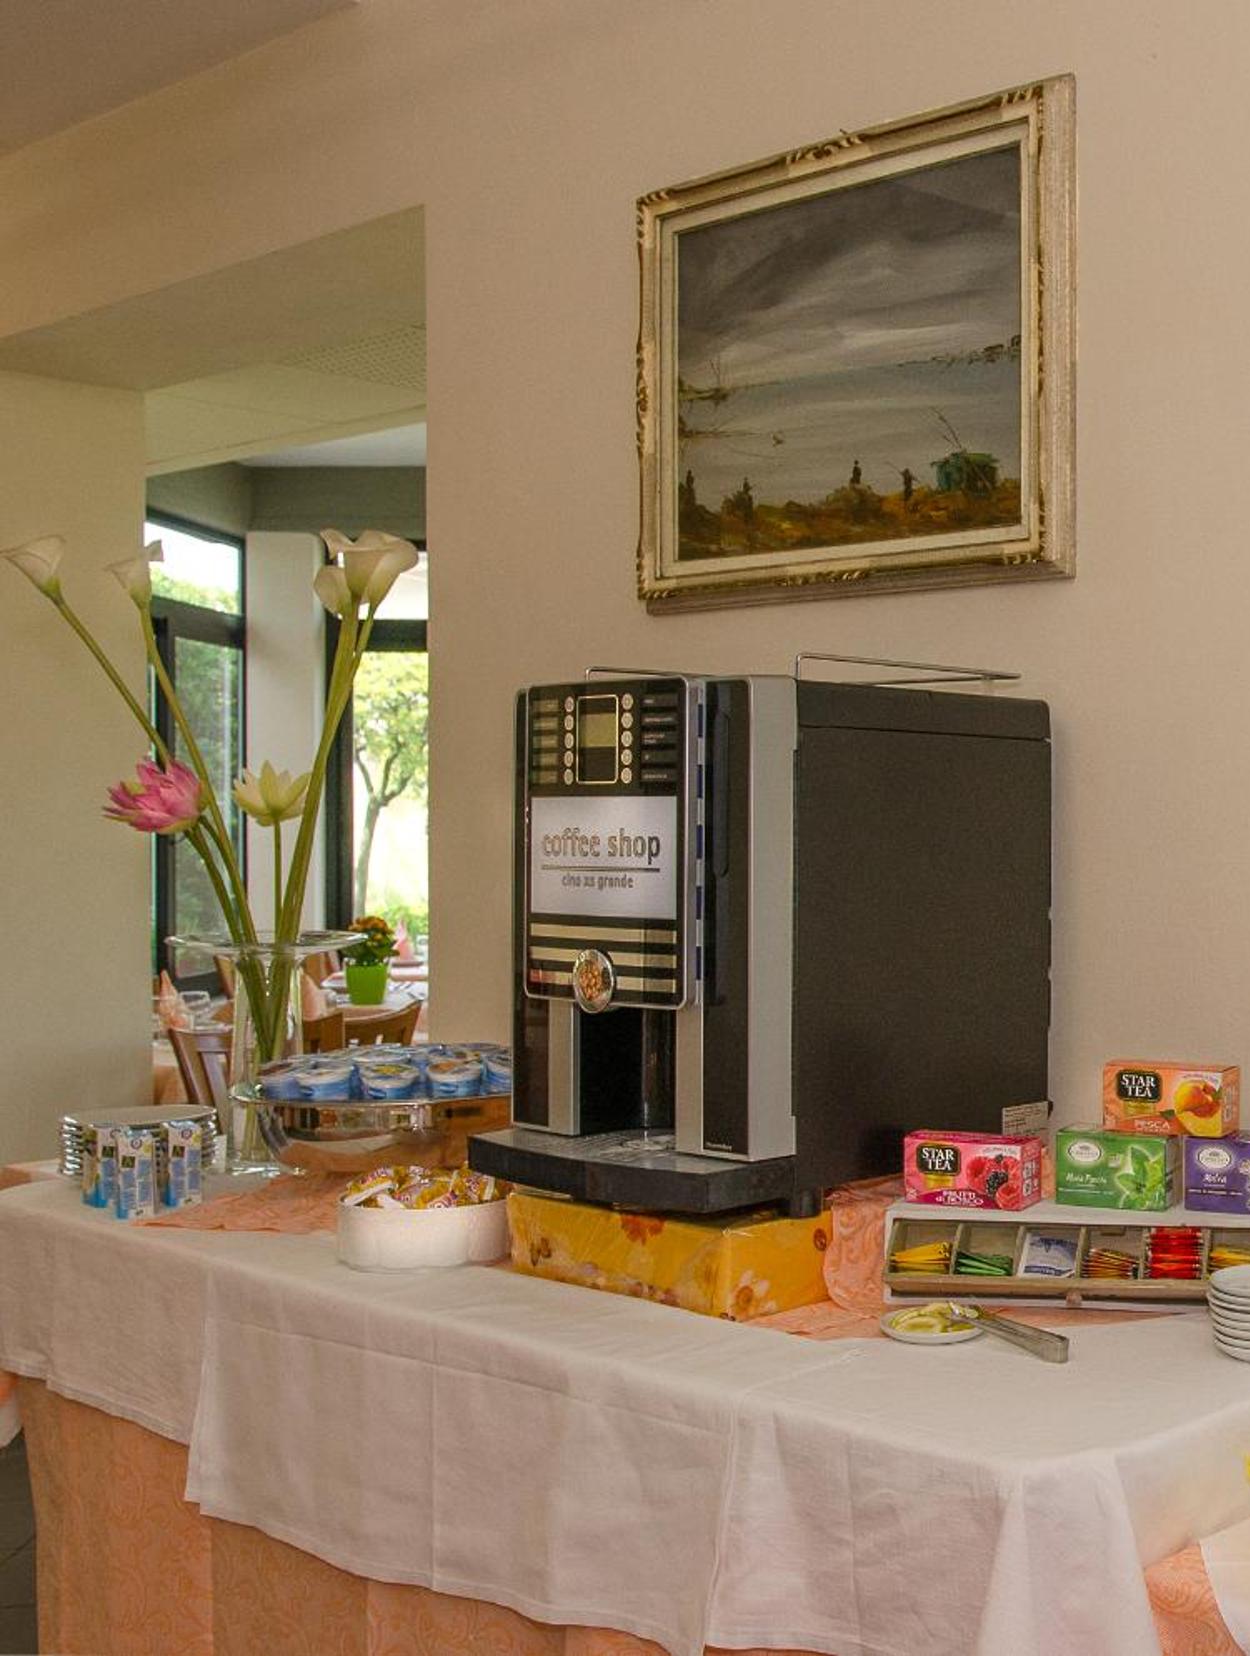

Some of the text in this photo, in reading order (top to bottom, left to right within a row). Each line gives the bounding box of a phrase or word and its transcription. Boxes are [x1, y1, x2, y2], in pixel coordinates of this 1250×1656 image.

[542, 827, 661, 865] coffee shop
[597, 875, 634, 891] grande
[1120, 1074, 1156, 1087] STAR
[1127, 1086, 1153, 1098] TEA
[922, 1147, 955, 1161] STAR
[926, 1158, 952, 1171] TEA
